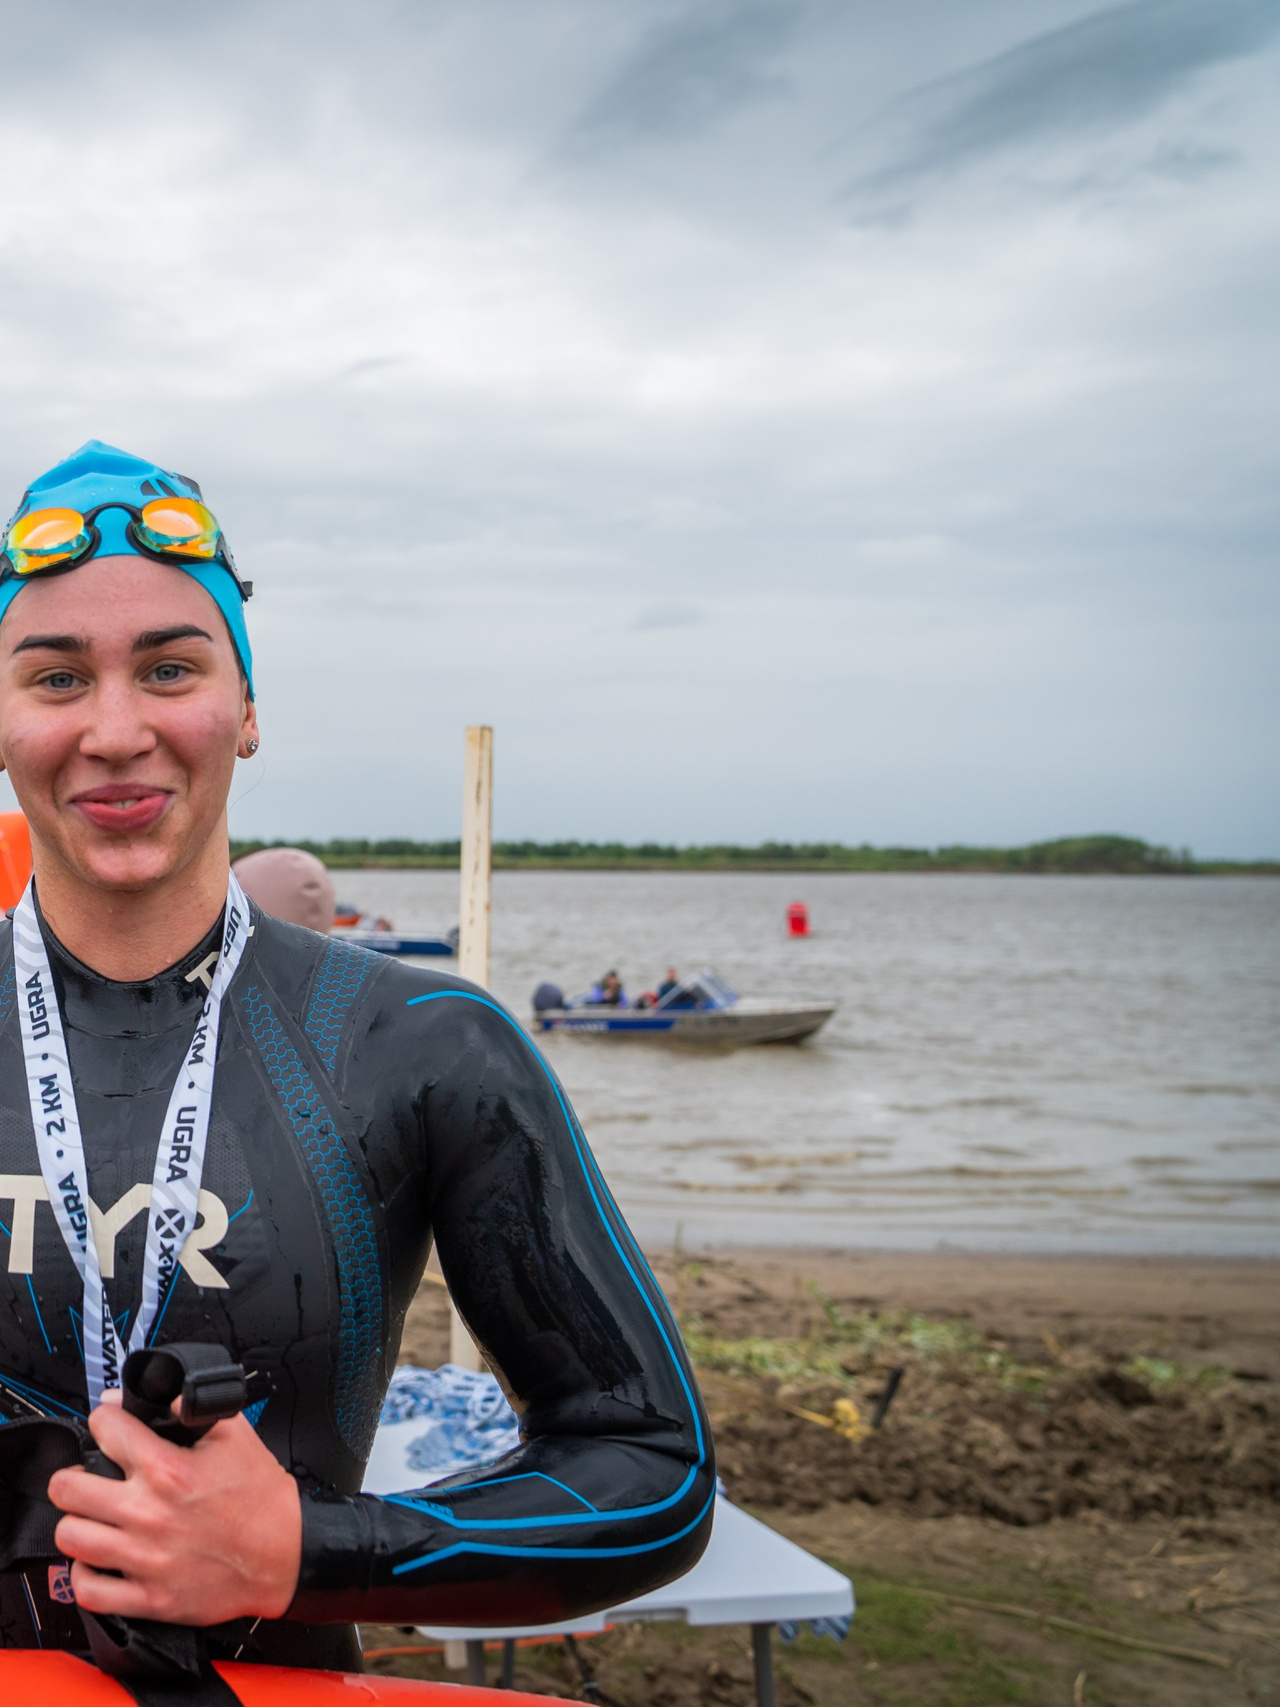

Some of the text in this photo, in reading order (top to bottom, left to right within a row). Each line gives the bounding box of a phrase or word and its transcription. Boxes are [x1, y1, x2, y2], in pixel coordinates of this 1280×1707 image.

[26, 970, 51, 1041] UGRA
[188, 1024, 208, 1066] KM
[39, 1073, 63, 1114] KM
[46, 1117, 66, 1137] 2
[166, 1105, 197, 1184] UGRA
